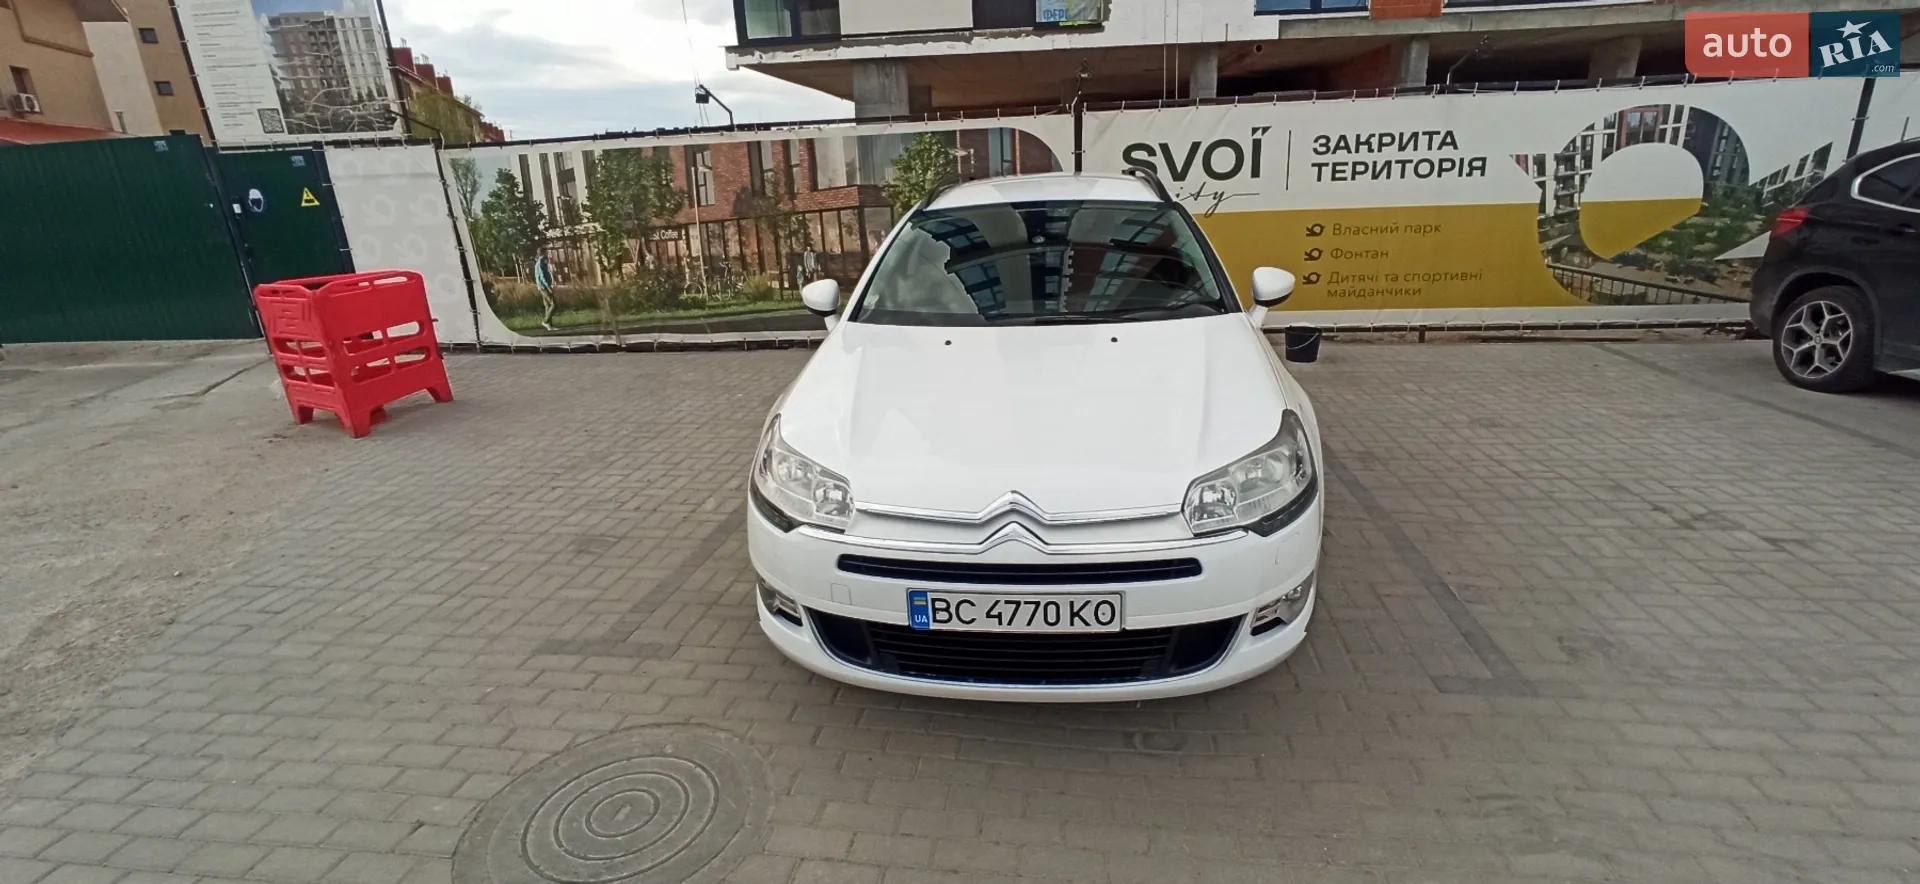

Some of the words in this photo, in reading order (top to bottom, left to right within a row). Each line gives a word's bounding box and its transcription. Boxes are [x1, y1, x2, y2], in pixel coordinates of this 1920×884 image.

[1312, 130, 1459, 155] ЗАКРИТА
[1311, 157, 1487, 182] ТЕРИТОРІЯ
[1332, 222, 1400, 236] Власний
[1404, 223, 1442, 237] парк
[1330, 247, 1389, 260] Фонтан
[1327, 270, 1379, 285] Дитячі
[1384, 273, 1399, 282] та
[1404, 269, 1483, 284] спортивні
[1327, 286, 1422, 298] майданчики
[914, 614, 928, 624] UA
[931, 597, 977, 625] BC
[985, 600, 1061, 627] 4770
[1069, 600, 1116, 627] KO
